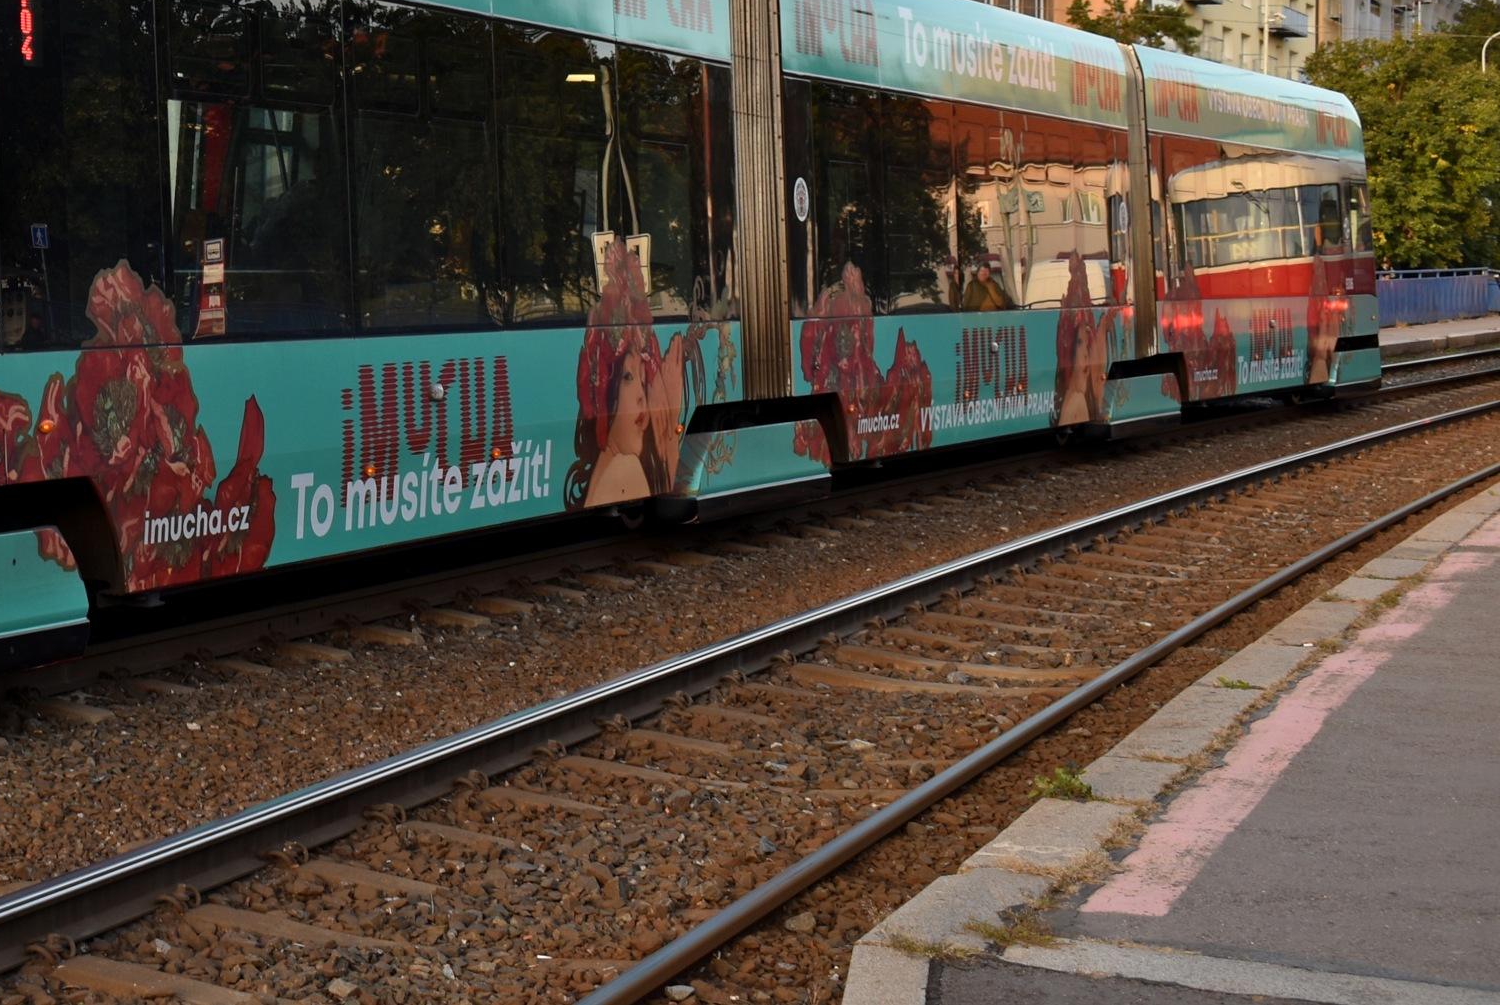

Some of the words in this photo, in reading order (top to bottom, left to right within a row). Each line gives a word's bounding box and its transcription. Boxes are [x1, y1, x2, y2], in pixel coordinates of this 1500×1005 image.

[897, 6, 928, 68] To
[932, 21, 1004, 82] musíte
[1008, 34, 1057, 93] zažít!
[857, 412, 900, 435] imucha.cz
[920, 399, 965, 433] VÝSTAVA
[967, 392, 1004, 425] OBECNÍ
[1004, 386, 1026, 419] DŮM
[143, 502, 251, 546] imucha.cz
[291, 472, 335, 541] To
[345, 452, 464, 532] musíte
[469, 439, 553, 510] zažít!
